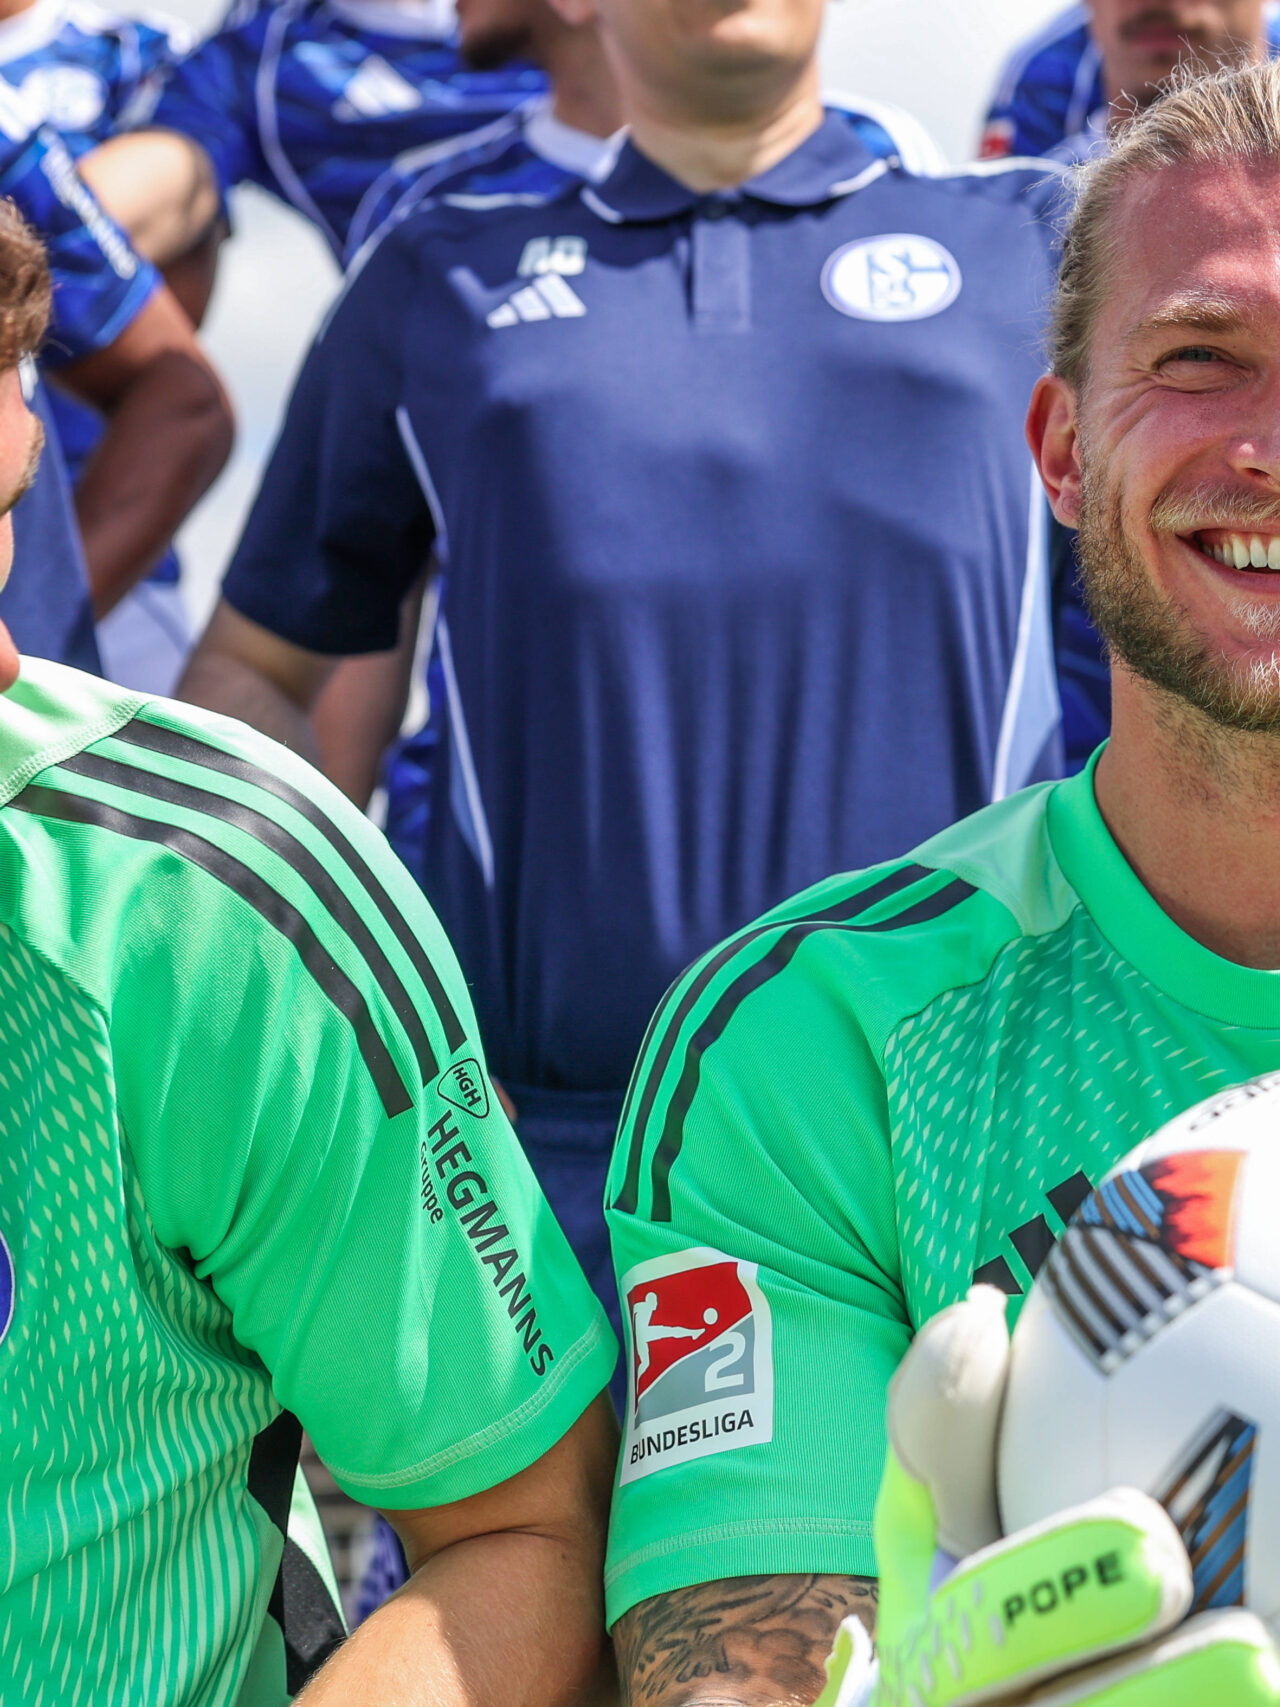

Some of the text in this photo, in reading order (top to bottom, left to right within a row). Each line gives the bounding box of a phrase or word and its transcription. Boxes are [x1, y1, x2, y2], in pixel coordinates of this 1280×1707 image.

[453, 1067, 481, 1107] HGH
[420, 1141, 444, 1224] Gruppe
[428, 1109, 554, 1376] HEGMANNS
[704, 1331, 747, 1393] 2
[630, 1409, 754, 1465] BUNDESLIGA
[1003, 1551, 1125, 1627] POPE
